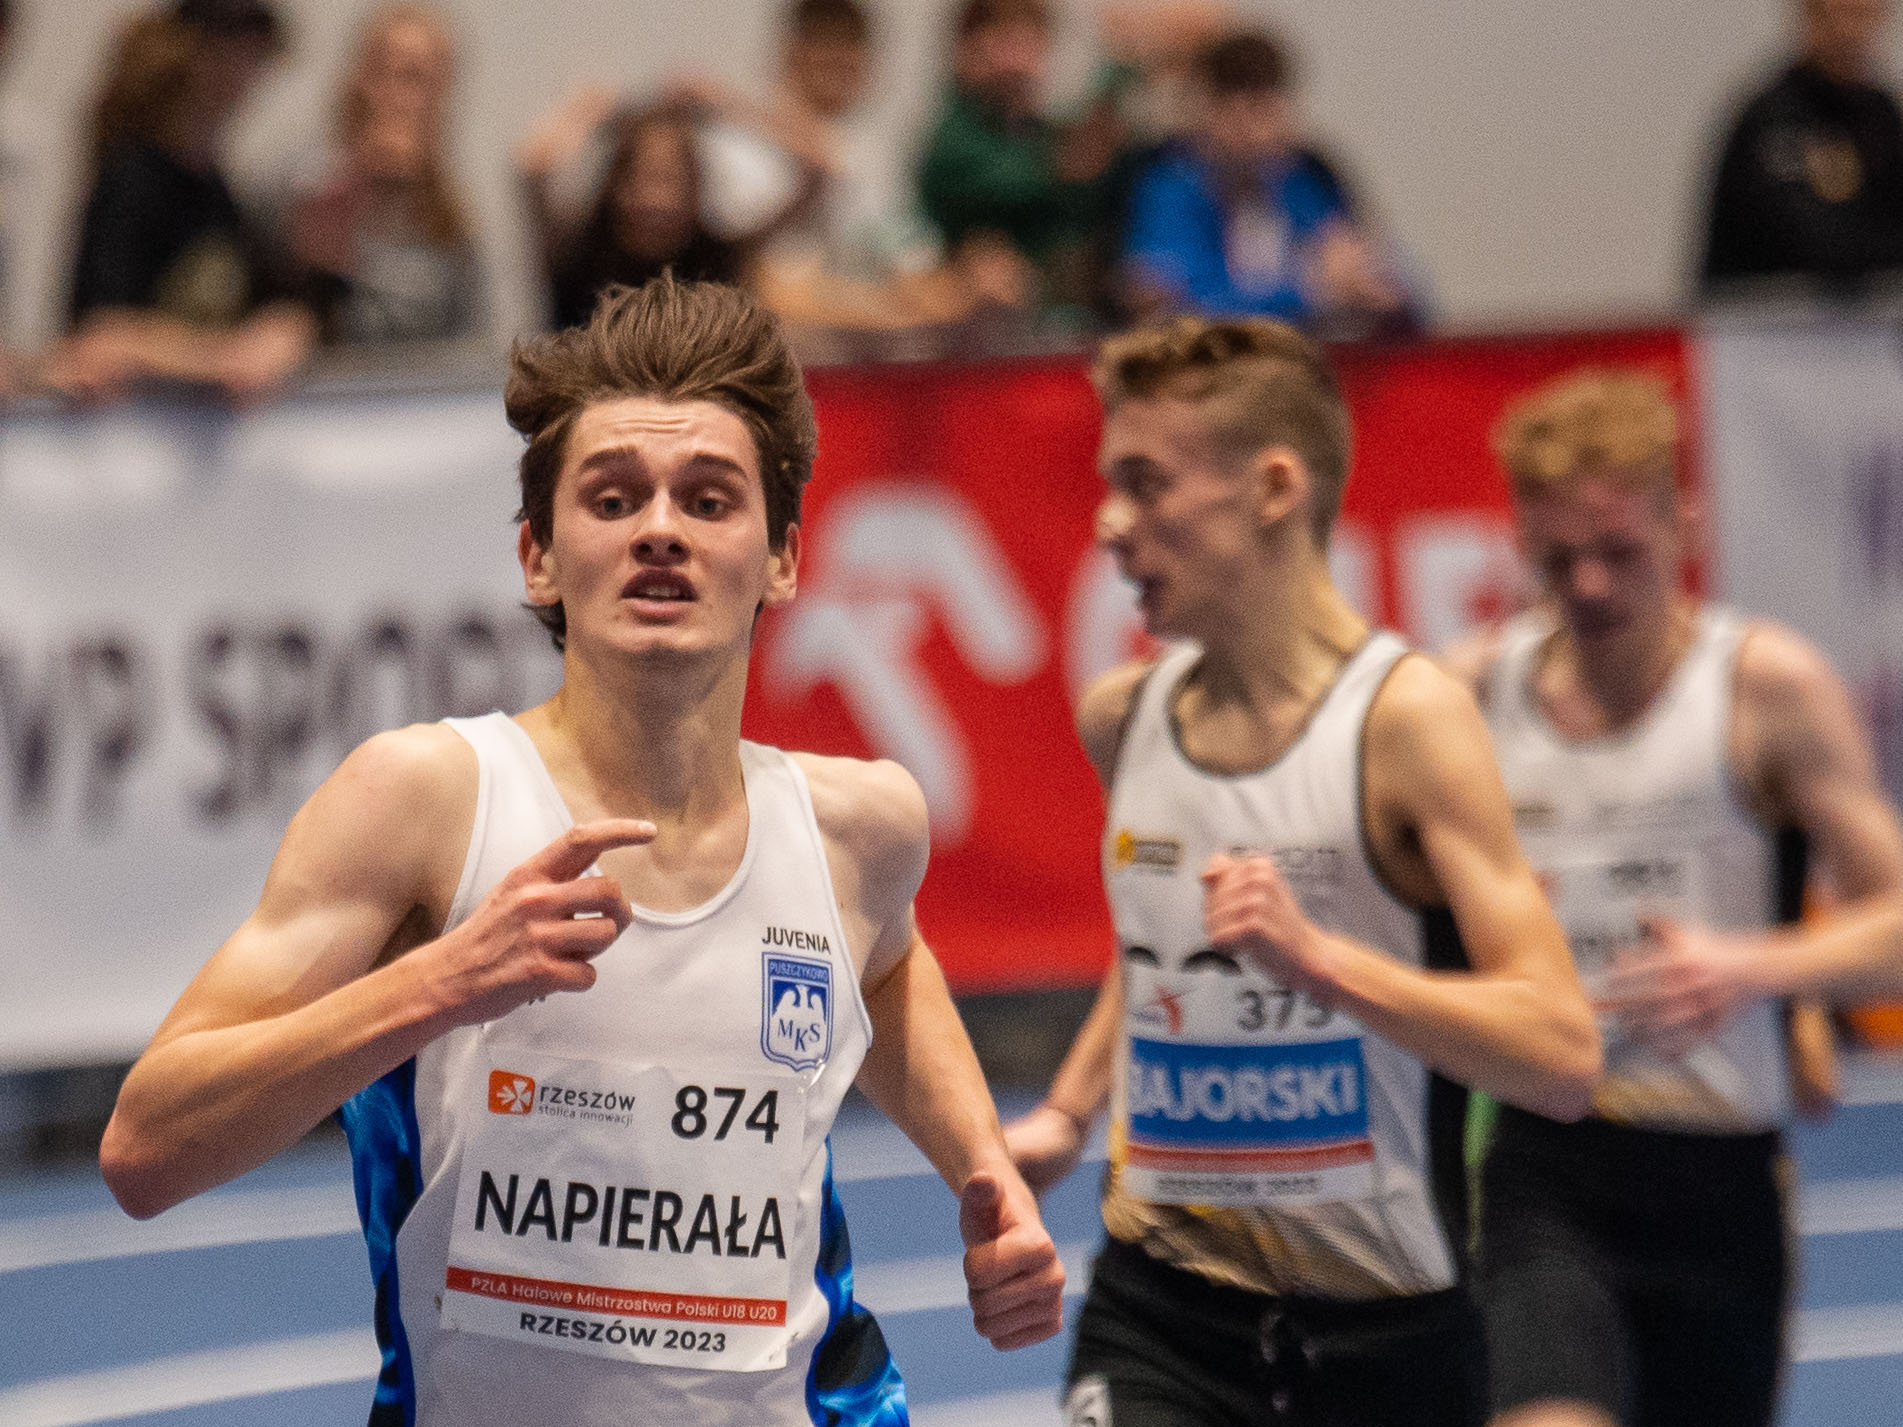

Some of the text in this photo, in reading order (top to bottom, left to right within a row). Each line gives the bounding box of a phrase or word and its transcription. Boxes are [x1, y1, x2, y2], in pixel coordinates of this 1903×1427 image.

[762, 927, 831, 955] JUVENIA
[777, 1018, 821, 1052] MKS
[538, 1103, 633, 1127] stolica innowacji
[539, 1083, 635, 1112] rzeszów
[671, 1085, 779, 1144] 874
[474, 1170, 787, 1260] NAPIERAŁA
[471, 1276, 777, 1320] PZLA Halowe Mistrzostwa Polski U18 U20
[519, 1312, 727, 1353] RZESZÓW 2023
